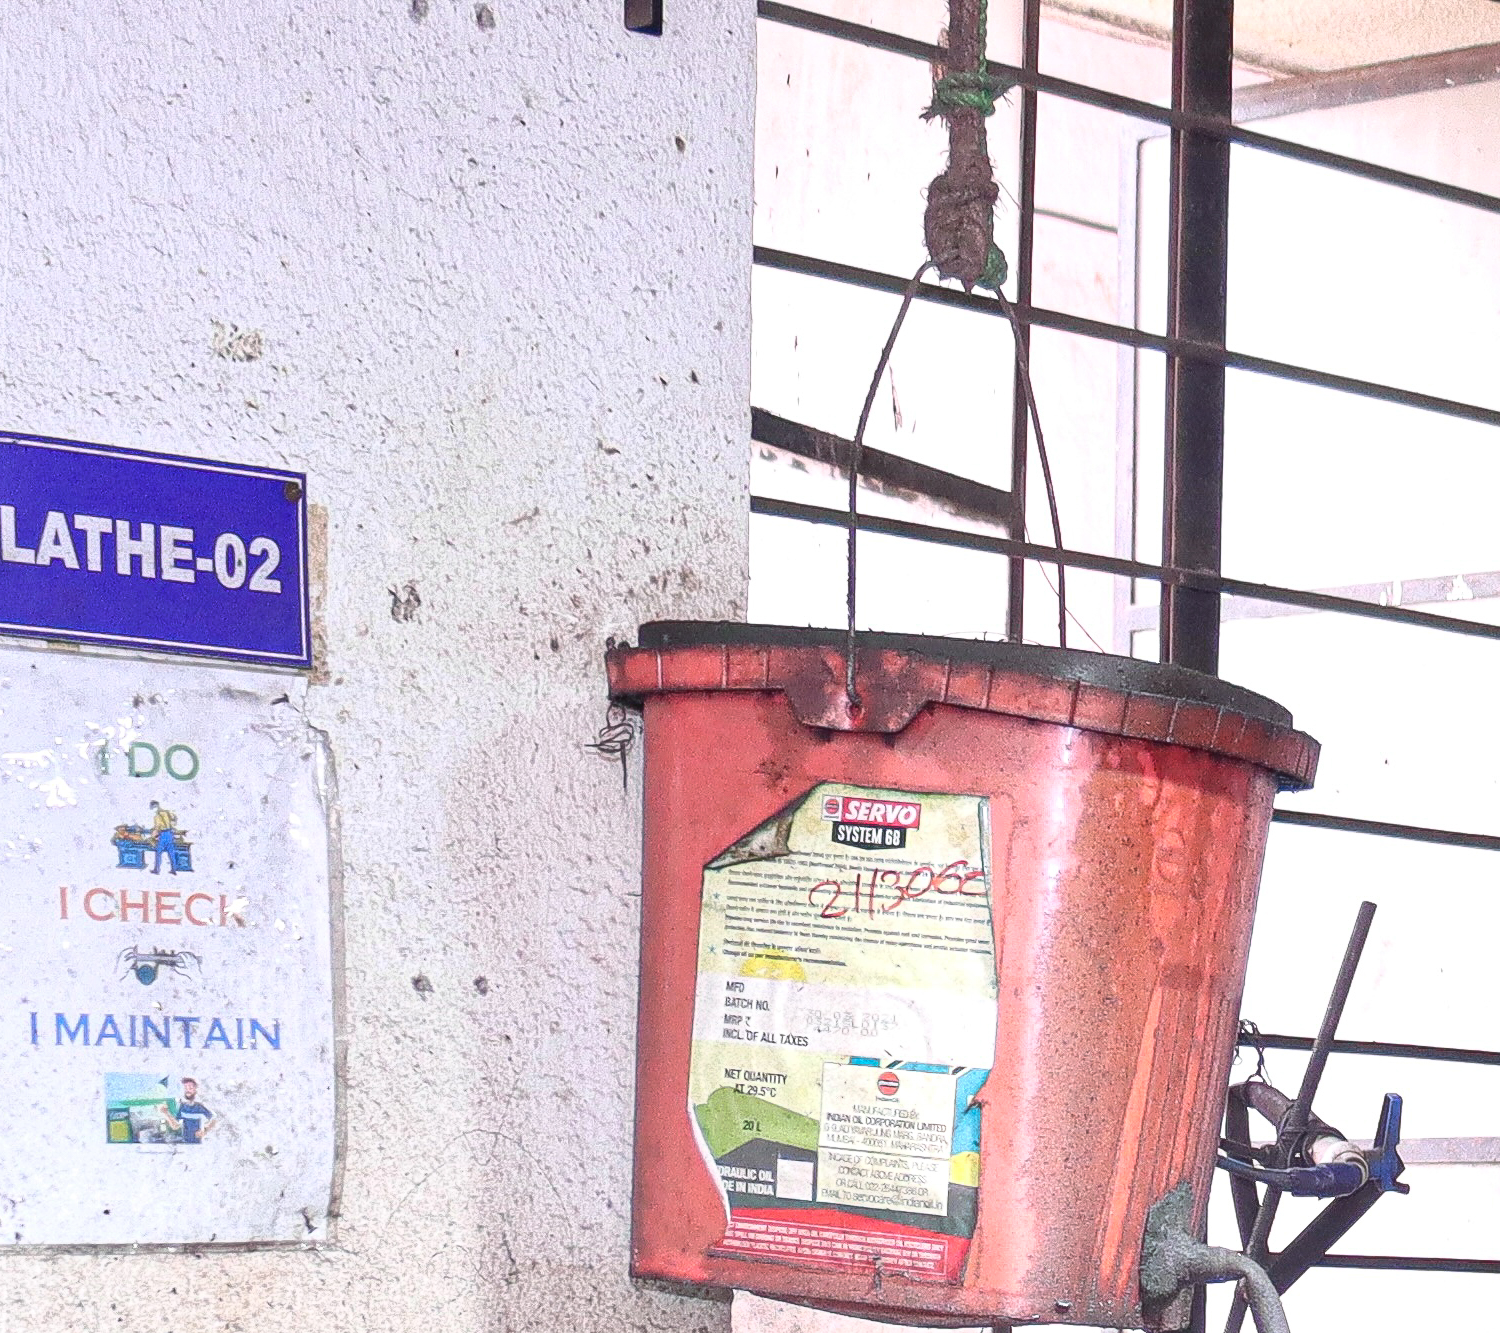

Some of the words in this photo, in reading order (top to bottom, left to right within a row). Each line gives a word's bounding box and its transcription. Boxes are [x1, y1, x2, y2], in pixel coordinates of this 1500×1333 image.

[0, 504, 284, 595] LATHE-02
[129, 741, 200, 781] DO
[844, 800, 917, 825] SERVO
[837, 825, 883, 845] SYSTEM
[885, 829, 900, 846] 68
[59, 886, 69, 920] I
[83, 887, 247, 928] CHECK
[725, 981, 745, 993] MFD
[725, 996, 753, 1009] BATCH
[724, 1014, 743, 1025] MRP
[29, 1012, 39, 1047] I
[54, 1012, 282, 1051] MAINTAIN
[745, 1029, 758, 1041] OF
[760, 1032, 777, 1044] ALL
[780, 1033, 809, 1047] TAXES
[724, 1068, 741, 1080] NET
[744, 1070, 788, 1085] QUANTITY
[733, 1083, 747, 1095] AT
[742, 1120, 755, 1131] 20
[826, 1112, 850, 1123] INDIAN
[852, 1115, 863, 1124] OIL
[865, 1116, 914, 1130] CORPORATION
[917, 1123, 947, 1132] LIMITED
[717, 1164, 757, 1180] DRAULIC
[758, 1169, 775, 1182] OIL
[747, 1183, 775, 1195] INDIA
